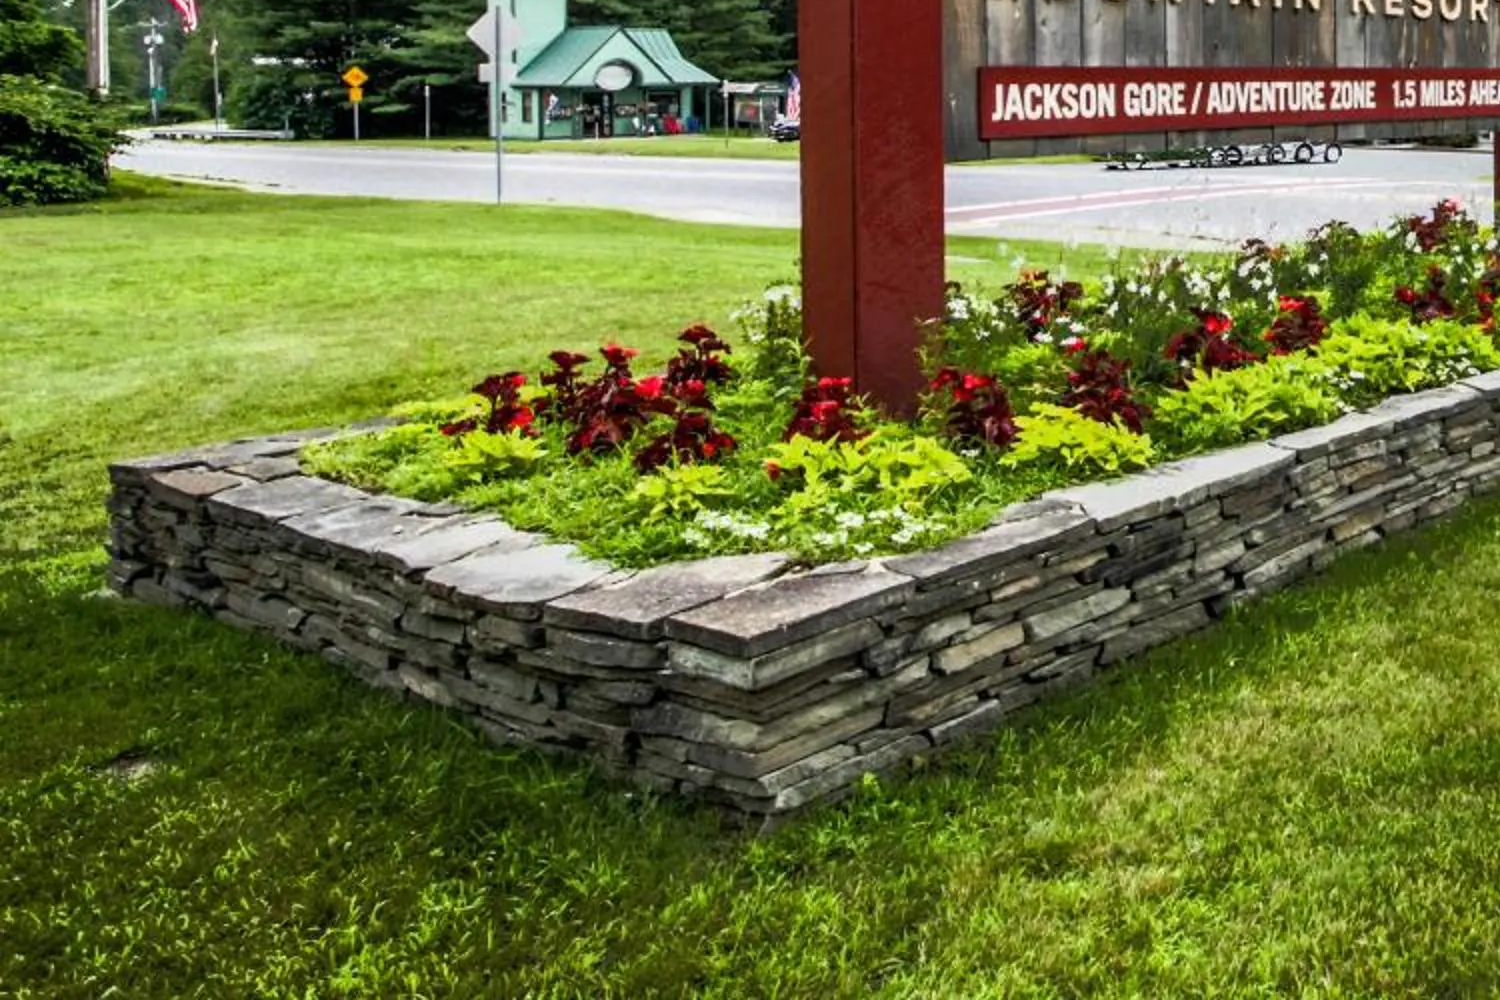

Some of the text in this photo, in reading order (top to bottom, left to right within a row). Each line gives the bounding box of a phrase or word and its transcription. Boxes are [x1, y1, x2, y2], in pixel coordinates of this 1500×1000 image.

[991, 82, 1116, 122] JACKSON
[1123, 81, 1186, 117] GORE
[1206, 80, 1326, 114] ADVENTURE
[1330, 80, 1377, 110] ZONE
[1391, 80, 1416, 109] 1.5
[1420, 78, 1465, 108] MILES
